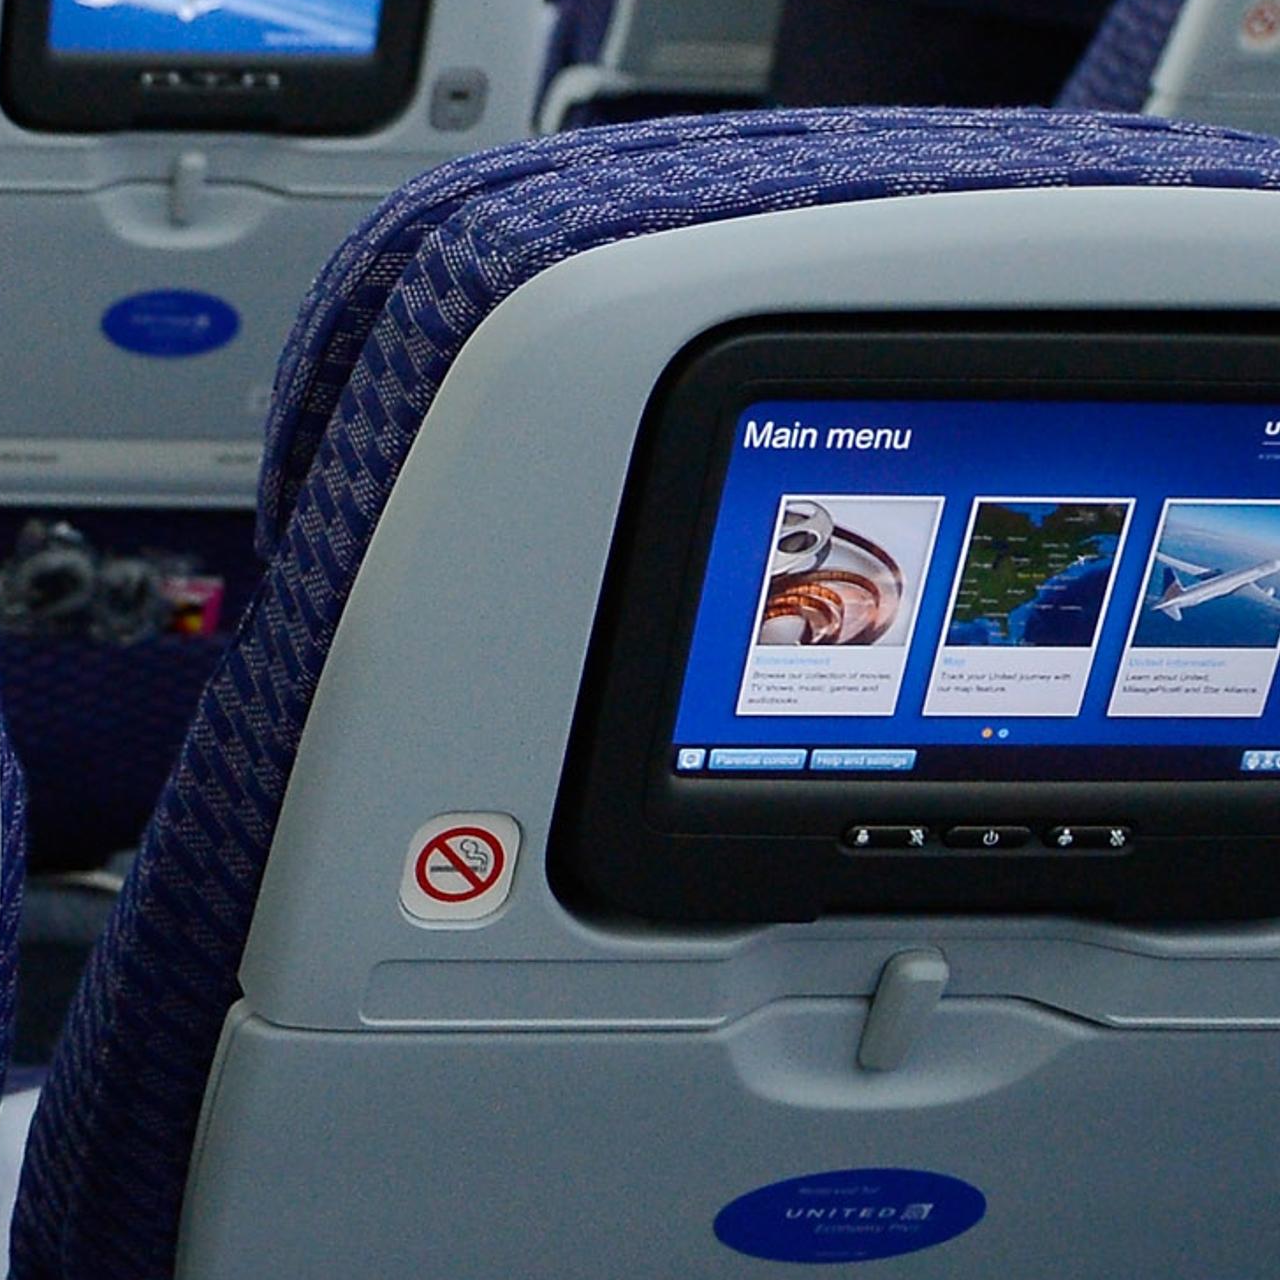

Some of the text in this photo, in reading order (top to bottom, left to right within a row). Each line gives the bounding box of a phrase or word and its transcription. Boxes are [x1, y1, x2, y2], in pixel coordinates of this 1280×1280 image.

[743, 420, 913, 449] Main menu
[785, 1207, 897, 1219] UNITED
